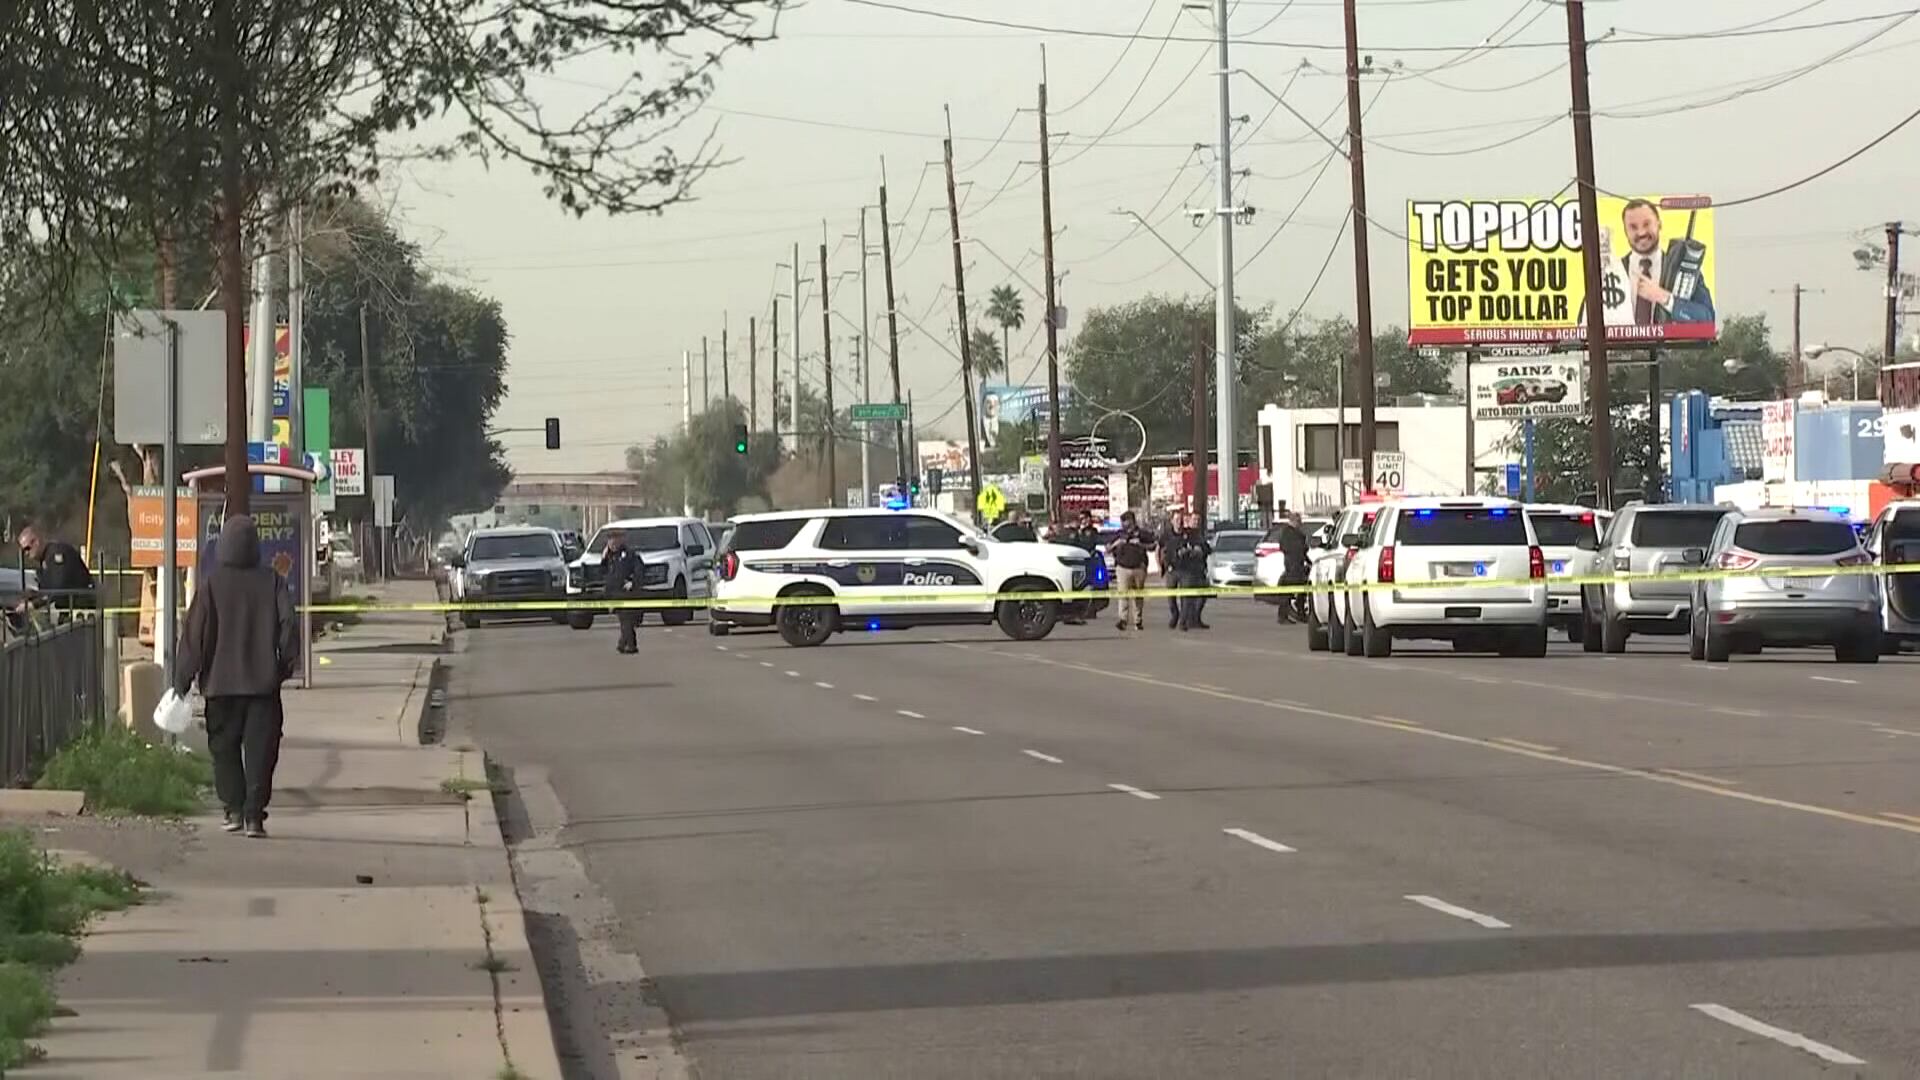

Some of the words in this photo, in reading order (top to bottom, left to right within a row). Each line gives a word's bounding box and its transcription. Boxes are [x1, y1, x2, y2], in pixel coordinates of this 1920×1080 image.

[1413, 200, 1583, 252] TOPDOG
[1425, 258, 1499, 292] GETS
[1507, 258, 1567, 292] YOU
[1426, 295, 1472, 321] TOP
[1479, 294, 1568, 321] DOLLAR
[1464, 328, 1506, 341] SERIOUS
[1509, 328, 1543, 340] INJURY
[1556, 328, 1588, 340] ACCID
[1607, 325, 1664, 338] ATTORNEYS
[1497, 365, 1553, 377] SAINZ
[1476, 407, 1499, 417] AUTO
[1501, 407, 1523, 416] BODY
[1532, 404, 1580, 415] COLLISION
[334, 451, 354, 463] LEY
[1375, 454, 1402, 462] SPEED
[338, 463, 361, 476] INC.
[1376, 471, 1401, 488] 40
[903, 571, 954, 586] Police
